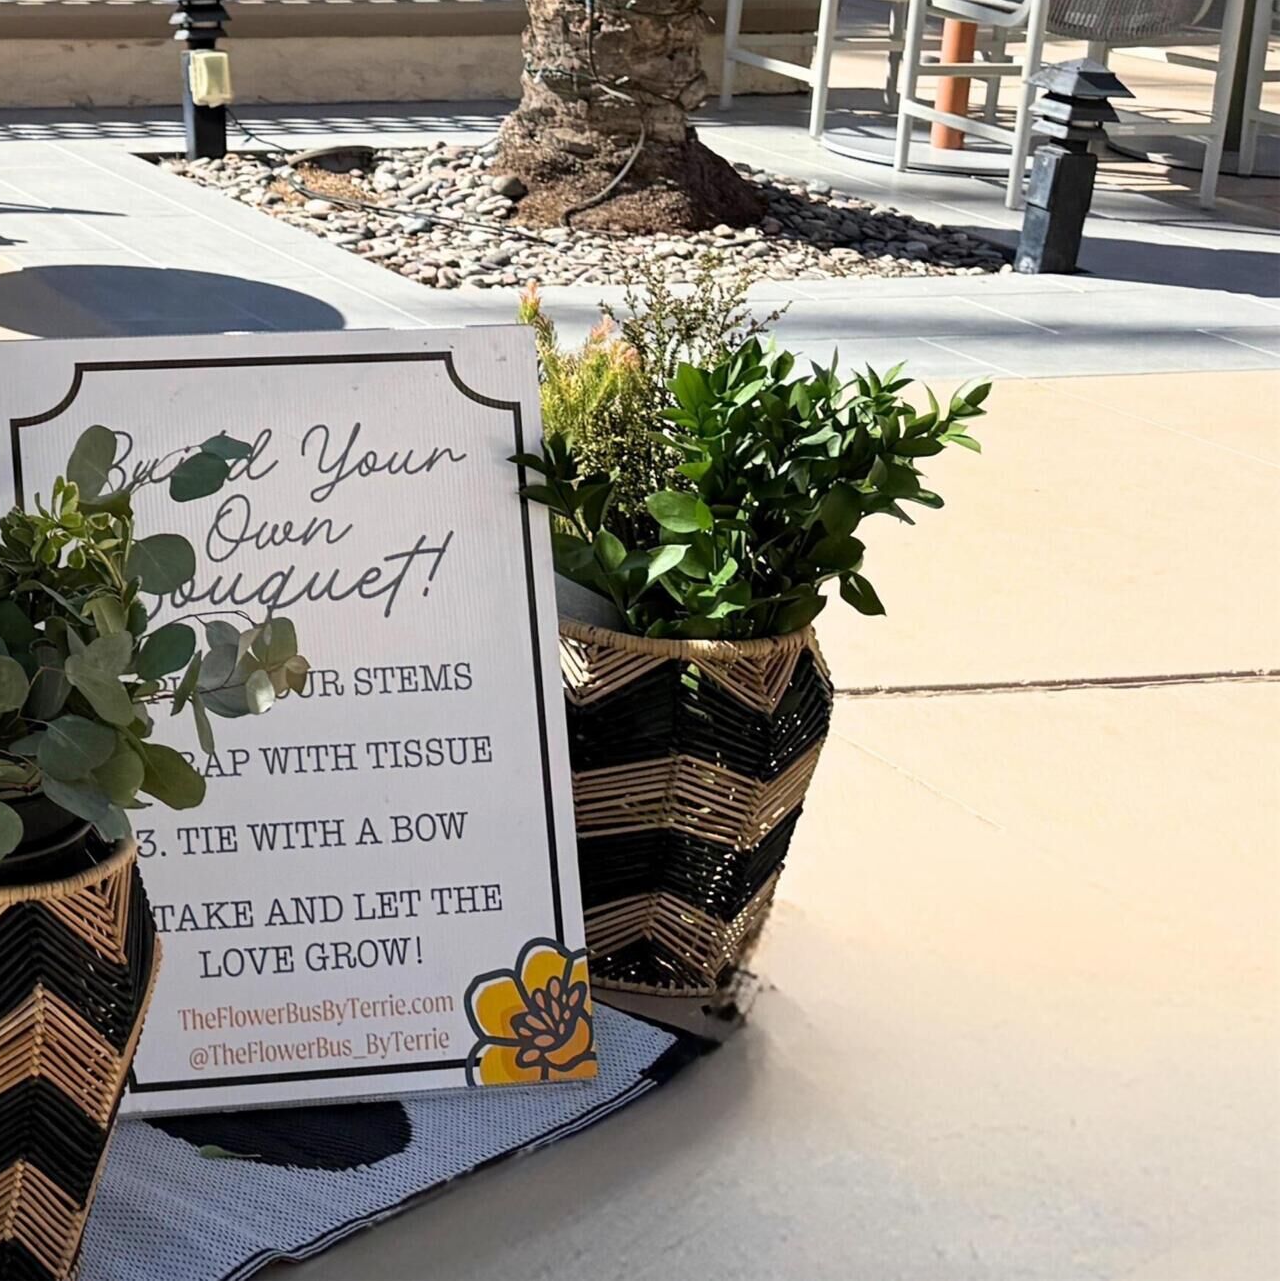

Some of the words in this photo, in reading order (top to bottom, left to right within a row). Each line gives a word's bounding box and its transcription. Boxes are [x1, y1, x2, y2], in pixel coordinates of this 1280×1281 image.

[301, 422, 467, 502] Your
[206, 494, 353, 562] Own
[148, 530, 453, 624] ouquet!
[354, 662, 473, 696] STEMS
[258, 743, 358, 775] WITH
[366, 735, 493, 769] TISSUE
[136, 829, 166, 858] 3.
[176, 825, 238, 855] TIE
[246, 819, 346, 852] WITH
[355, 817, 382, 845] A
[389, 811, 469, 843] BOW
[152, 900, 254, 933] TAKE
[264, 894, 344, 926] AND
[353, 889, 422, 921] LET
[430, 884, 503, 916] THE
[198, 945, 295, 979] LOVE
[305, 935, 424, 971] GROW!
[178, 993, 455, 1032] TheFlowerBusByTerrie.com
[188, 1027, 451, 1070] @TheFlowerBus_ByTerrie
